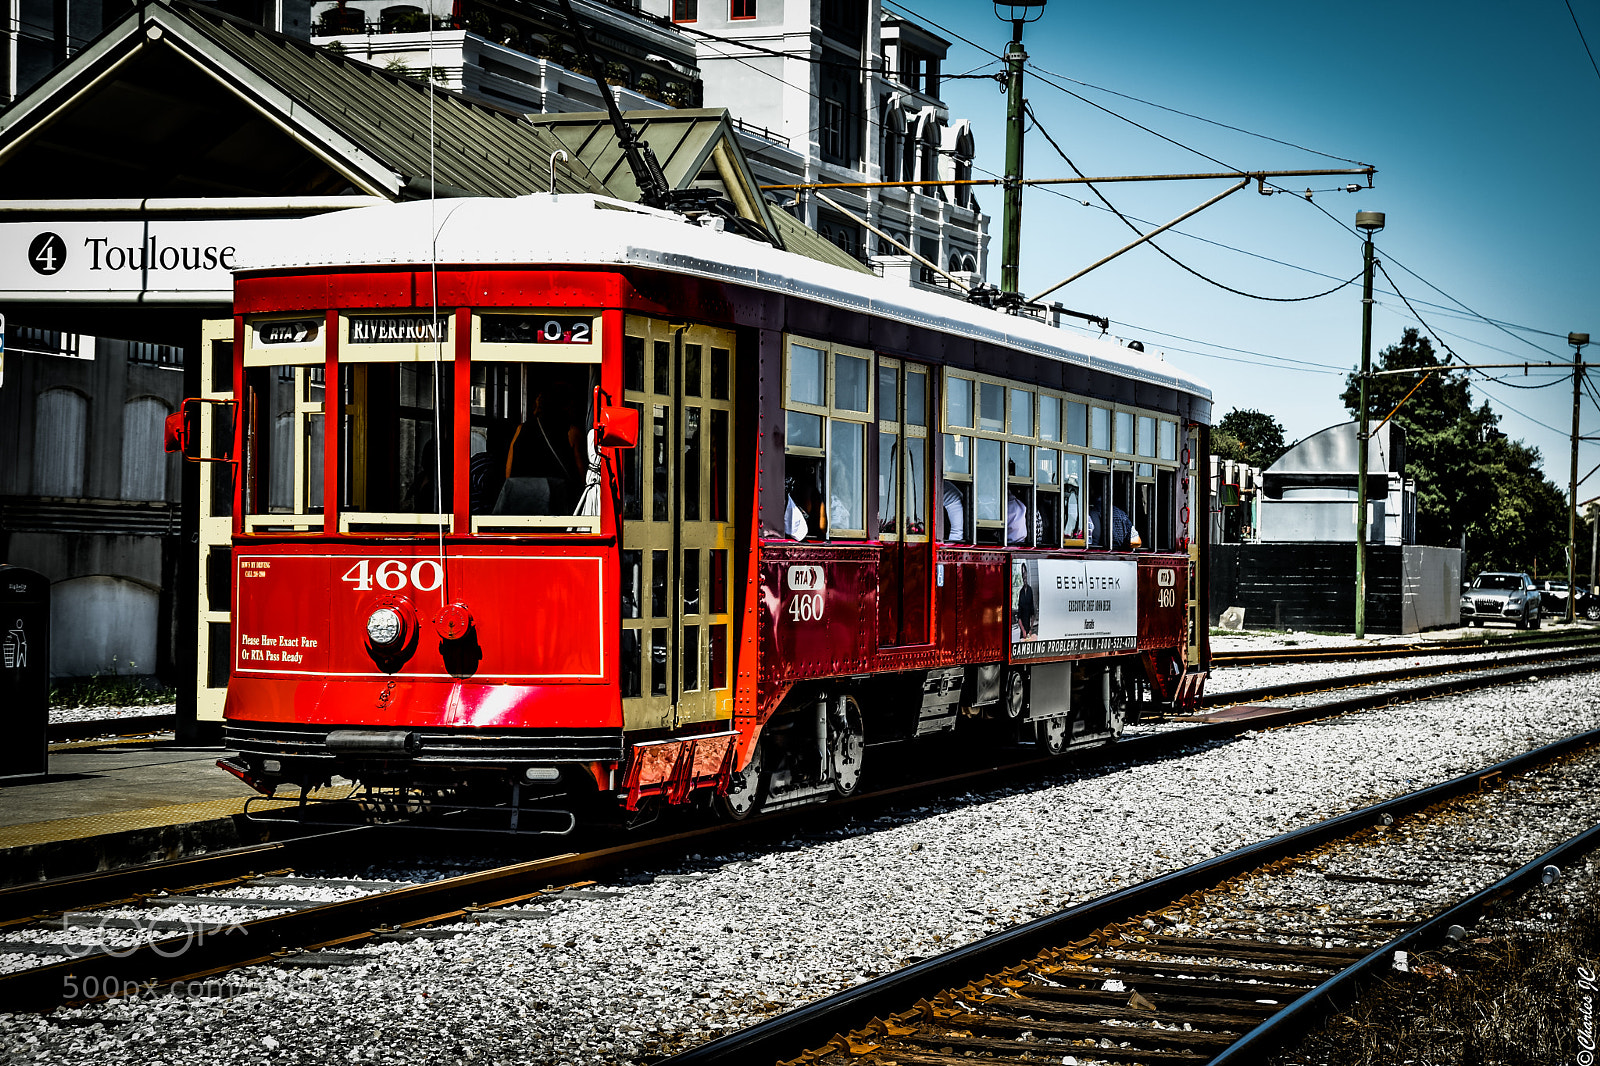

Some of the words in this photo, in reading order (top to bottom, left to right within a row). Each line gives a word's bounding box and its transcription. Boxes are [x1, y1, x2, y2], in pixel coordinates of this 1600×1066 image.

[36, 236, 57, 271] 4
[84, 235, 236, 271] Toulouse
[269, 327, 293, 340] RTA
[353, 319, 446, 339] RIVERFRONT
[341, 559, 444, 592] 460
[1056, 576, 1084, 590] BESH
[1089, 576, 1121, 590] STEAK
[1158, 588, 1175, 608] 460
[788, 593, 824, 622] 460
[241, 634, 260, 646] Please
[261, 634, 277, 646] Have
[279, 635, 299, 647] Exact
[301, 636, 318, 648] Fare
[1012, 642, 1046, 656] GAMBLING
[1047, 639, 1078, 653] PROBLEM?
[1079, 639, 1094, 651] CALL
[241, 648, 249, 660] Or
[251, 649, 264, 661] RTA
[265, 650, 280, 662] Pass
[281, 650, 303, 664] Ready
